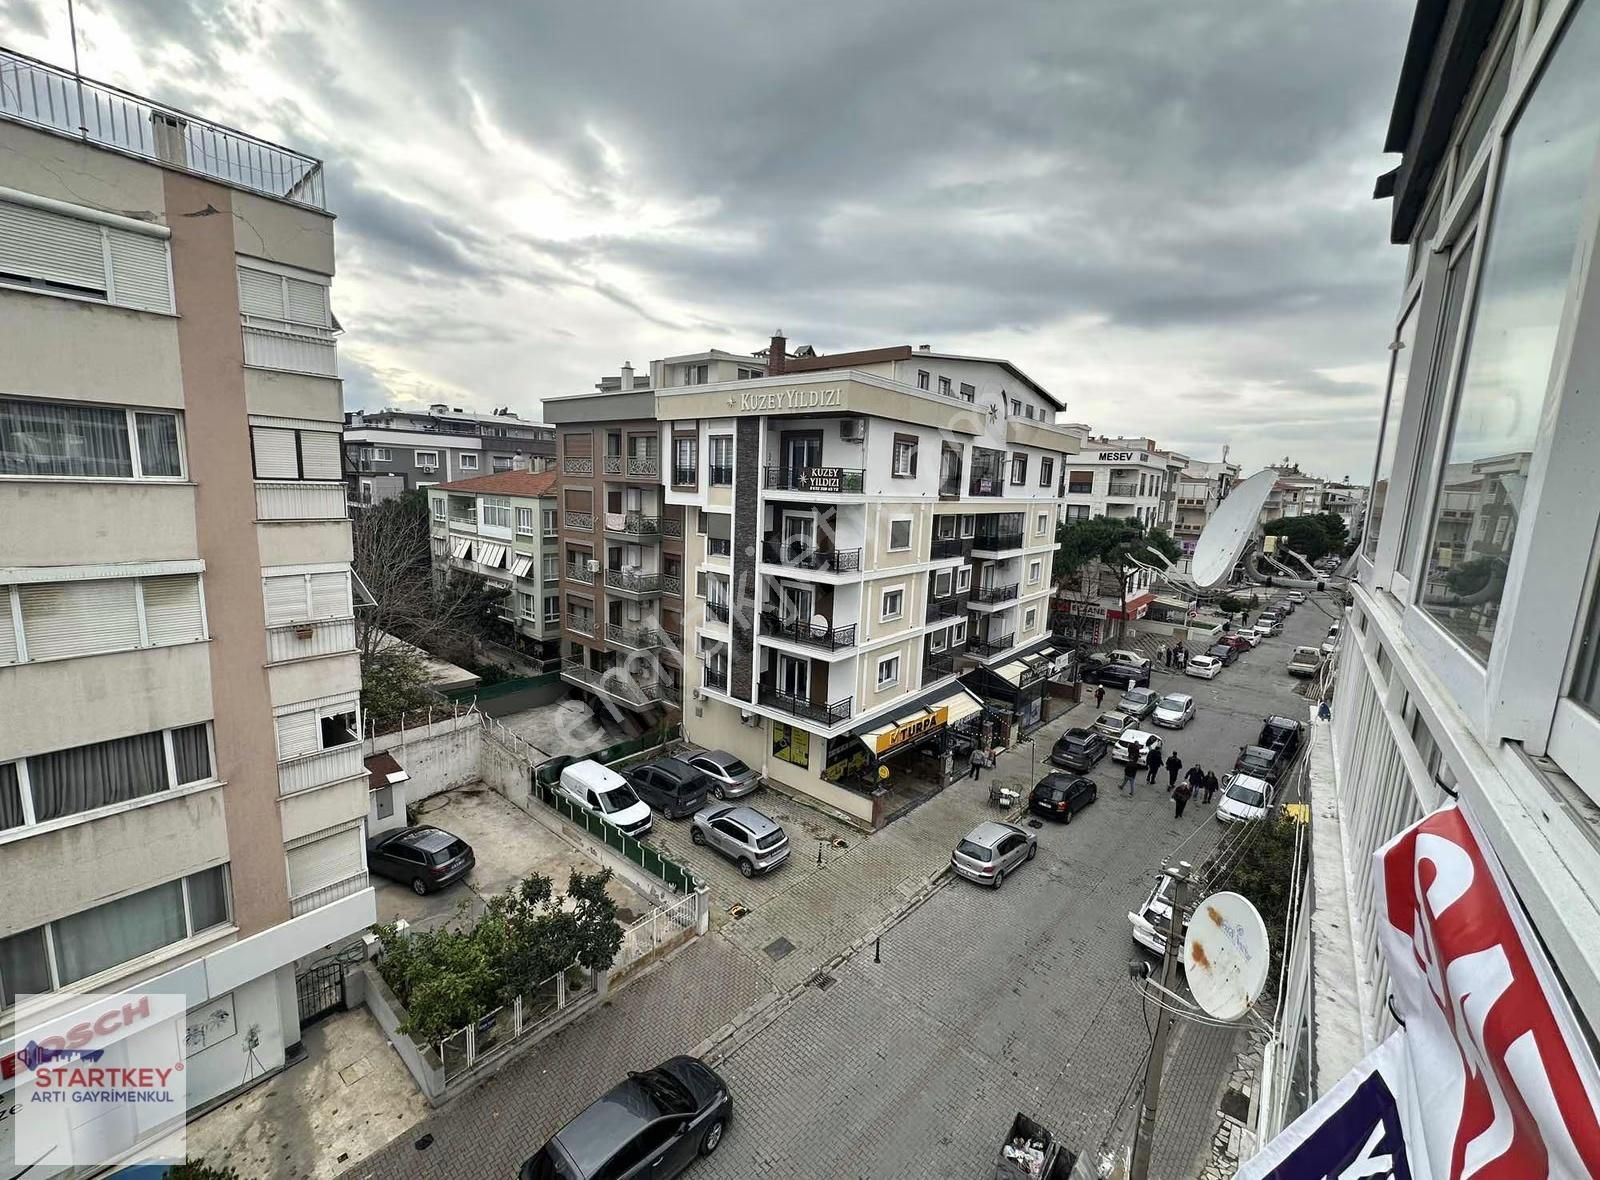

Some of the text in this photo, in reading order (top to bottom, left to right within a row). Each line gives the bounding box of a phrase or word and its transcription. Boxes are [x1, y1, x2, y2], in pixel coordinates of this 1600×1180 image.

[741, 388, 841, 412] KUZEY YILDIZI
[1099, 452, 1133, 461] MESEV
[811, 468, 839, 477] KUZEY
[810, 477, 839, 487] YILDIZI
[901, 716, 937, 741] TURPA
